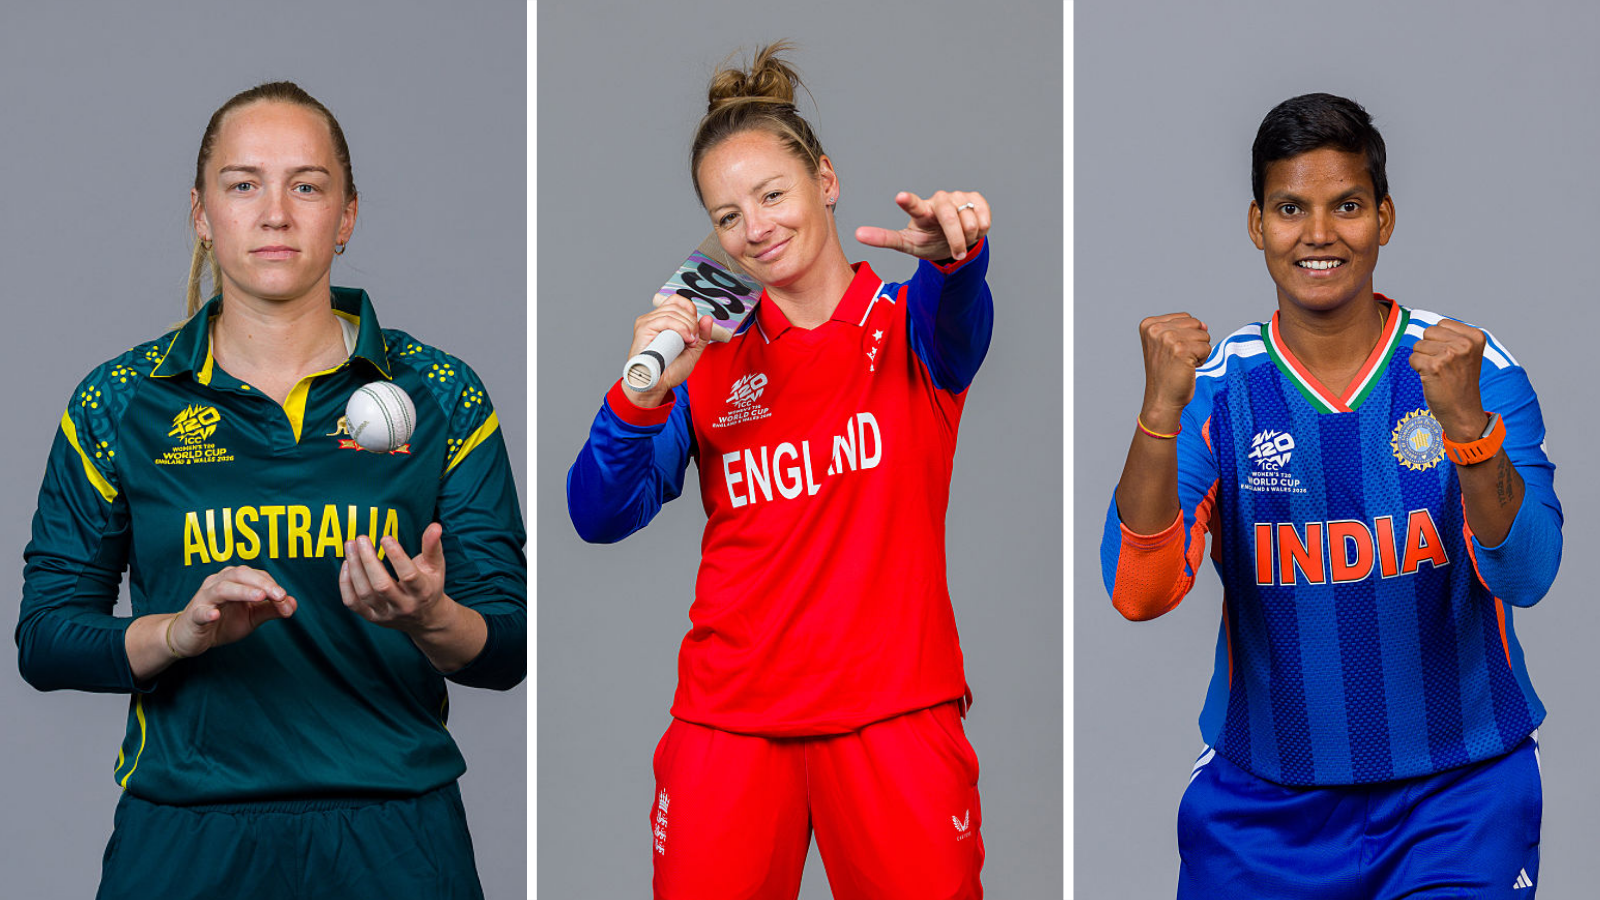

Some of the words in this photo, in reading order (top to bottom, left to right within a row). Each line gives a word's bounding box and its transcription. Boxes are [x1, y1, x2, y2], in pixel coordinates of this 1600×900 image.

[737, 400, 752, 408] ICC
[718, 411, 749, 423] WORLD
[751, 407, 769, 416] CUP
[184, 436, 202, 446] ICC
[172, 444, 203, 452] WOMEN'S
[163, 450, 203, 460] WORLD
[204, 447, 227, 457] CUP
[154, 457, 185, 465] ENGLAND
[1262, 462, 1279, 471] ICC
[1280, 478, 1301, 487] CUP
[1254, 508, 1450, 586] INDIA
